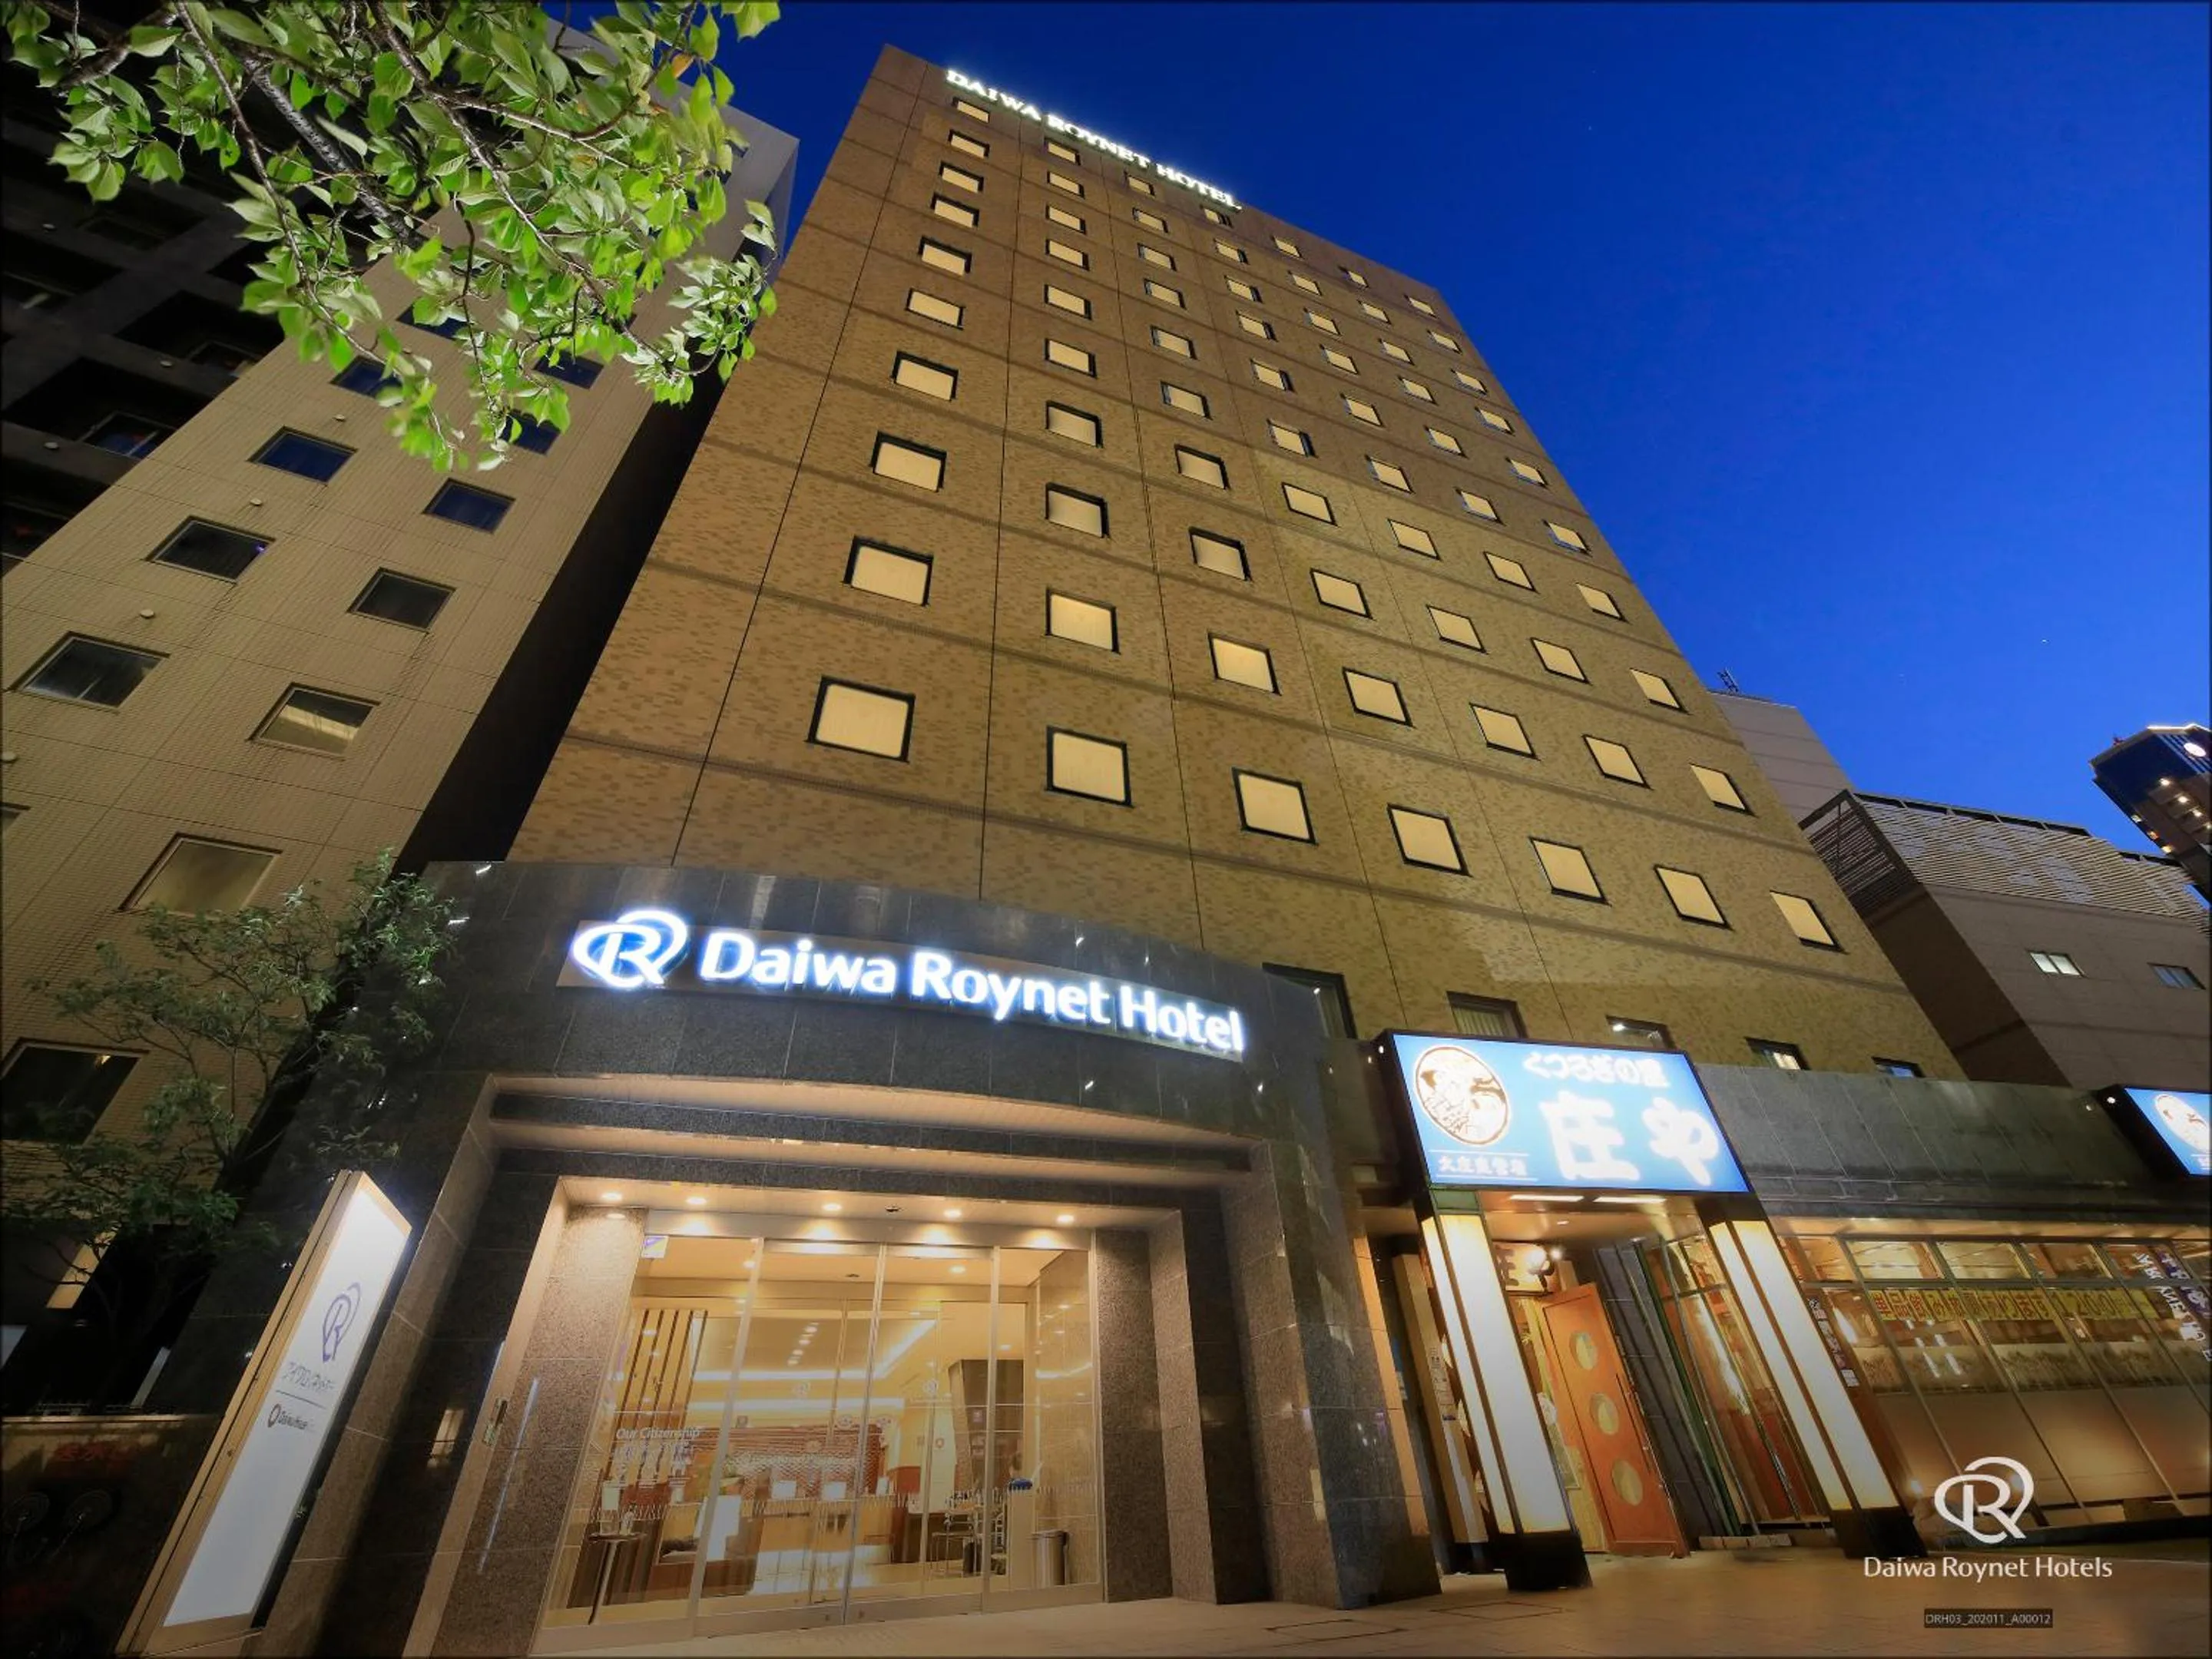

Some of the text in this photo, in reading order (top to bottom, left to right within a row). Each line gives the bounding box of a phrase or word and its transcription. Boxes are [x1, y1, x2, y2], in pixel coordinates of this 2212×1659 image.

[945, 68, 1041, 121] DAIWA
[1156, 162, 1243, 210] HOTEL
[700, 929, 896, 994] Daiwa
[911, 950, 1112, 1022] Roynet
[1119, 982, 1246, 1053] Hotel
[1538, 1090, 1720, 1187] 庄や
